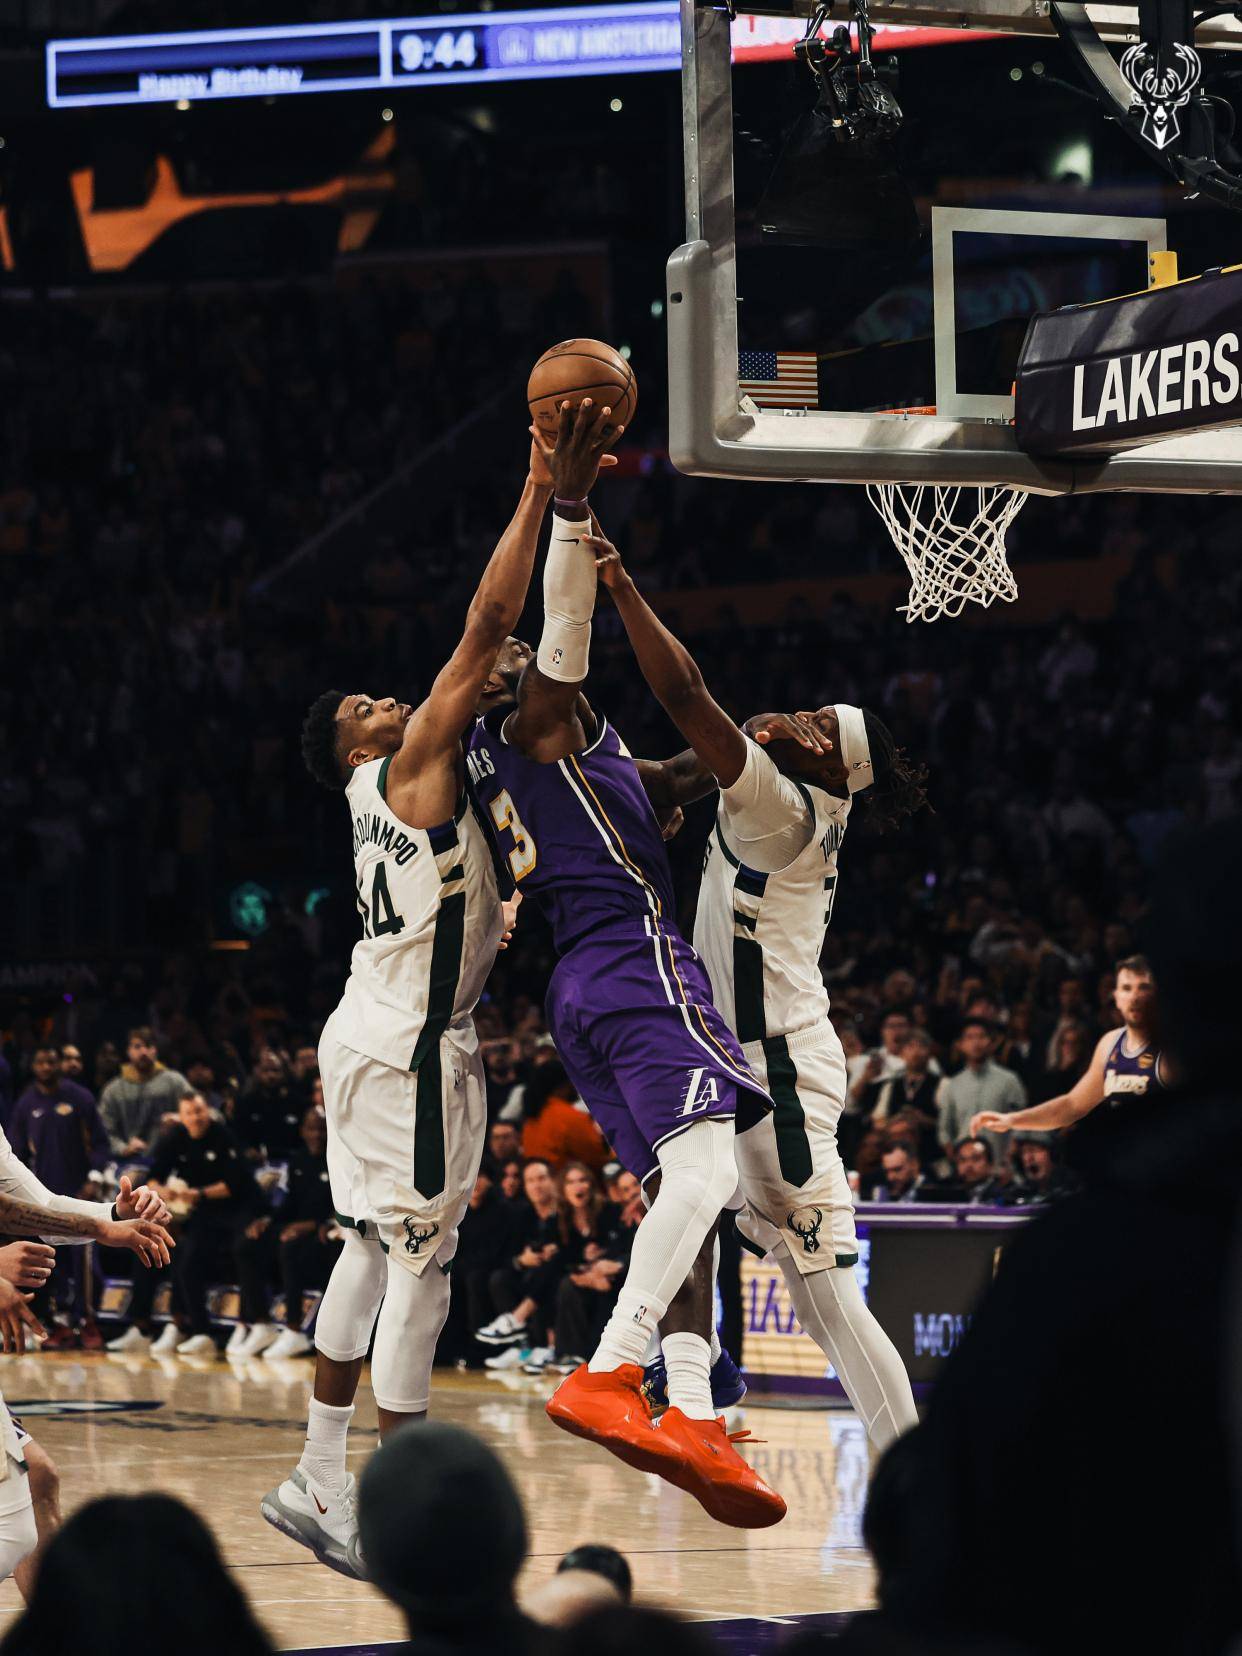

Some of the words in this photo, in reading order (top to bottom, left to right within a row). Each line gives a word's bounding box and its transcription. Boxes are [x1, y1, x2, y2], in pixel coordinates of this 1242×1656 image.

[399, 32, 476, 71] 9:44
[1072, 332, 1240, 431] LAKERS
[489, 788, 537, 882] 3
